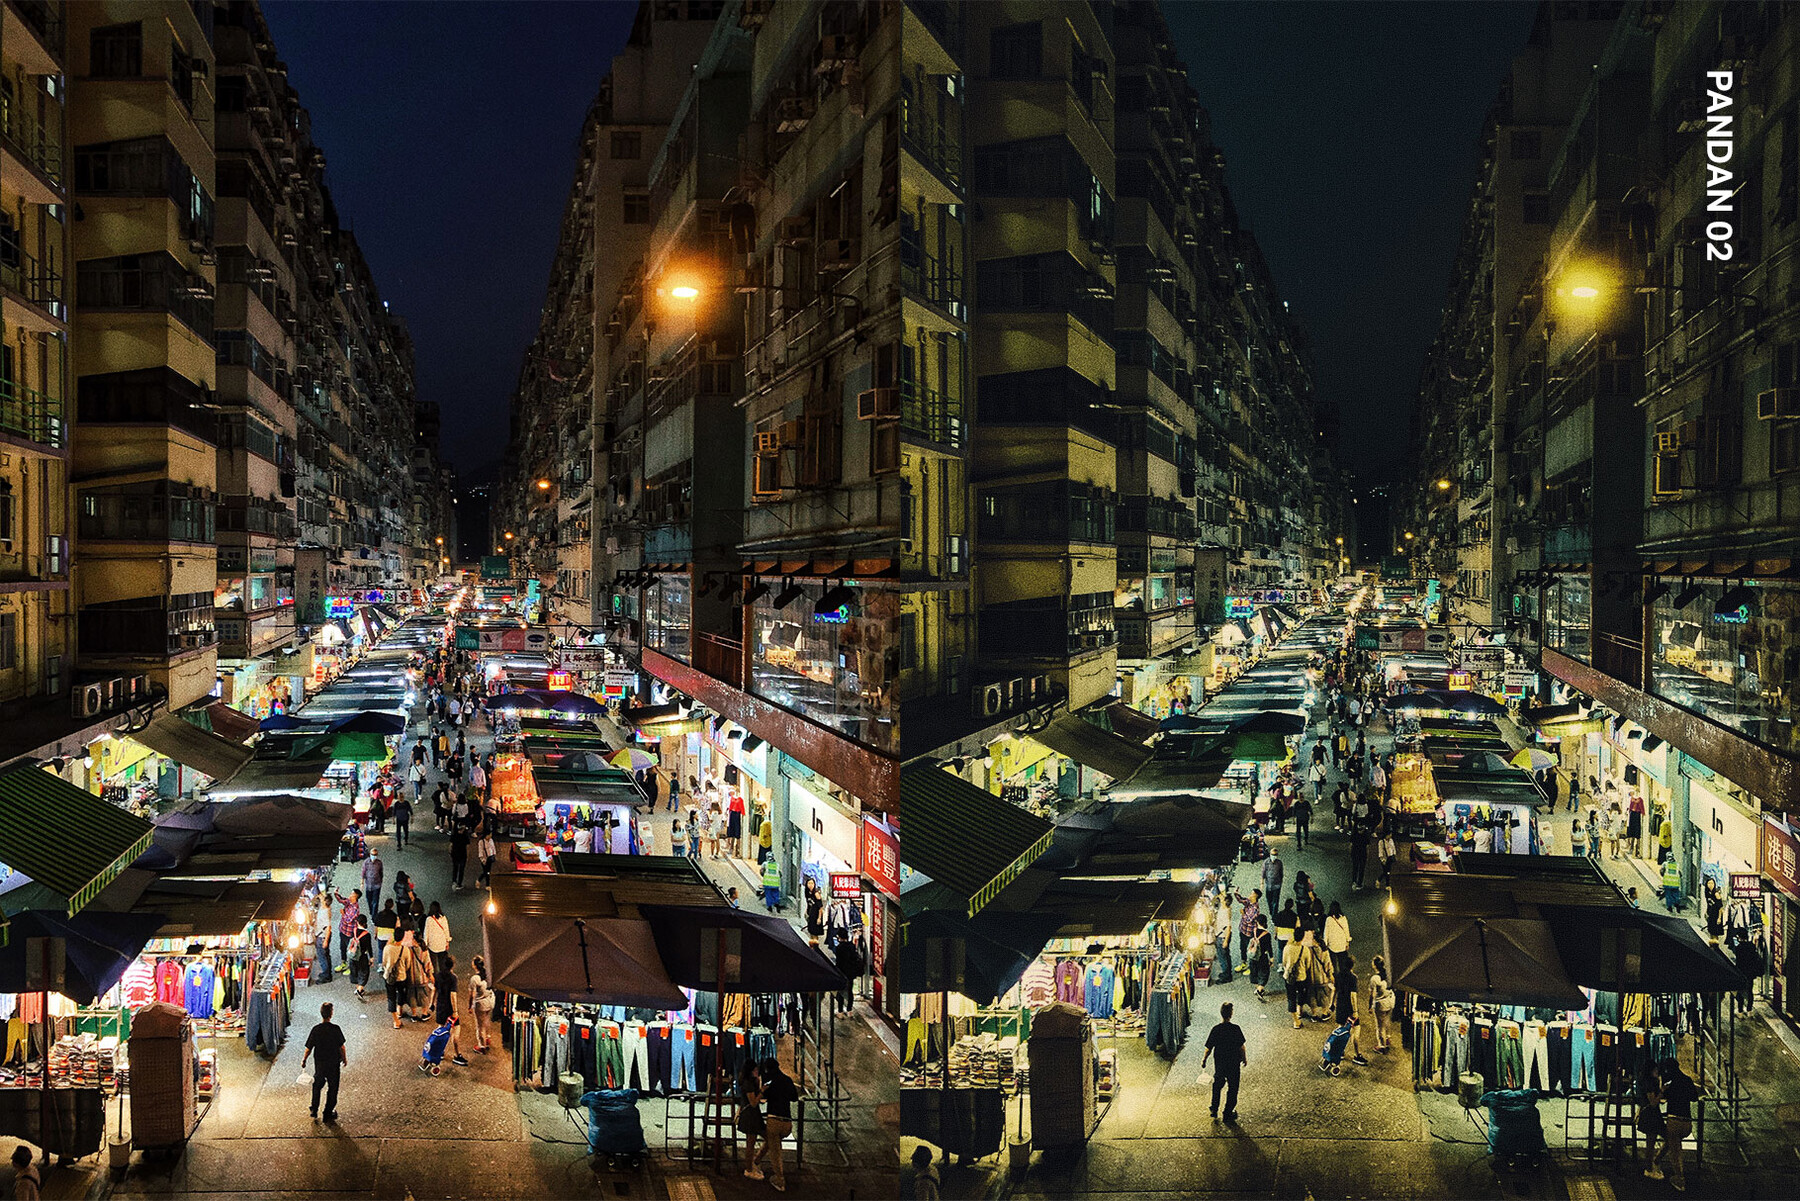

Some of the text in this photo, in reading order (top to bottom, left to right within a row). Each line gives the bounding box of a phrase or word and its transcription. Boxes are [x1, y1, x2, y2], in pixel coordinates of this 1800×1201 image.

[812, 807, 823, 835] In
[1712, 807, 1723, 835] In
[867, 833, 897, 884] 港豐
[1767, 833, 1797, 884] 港豐
